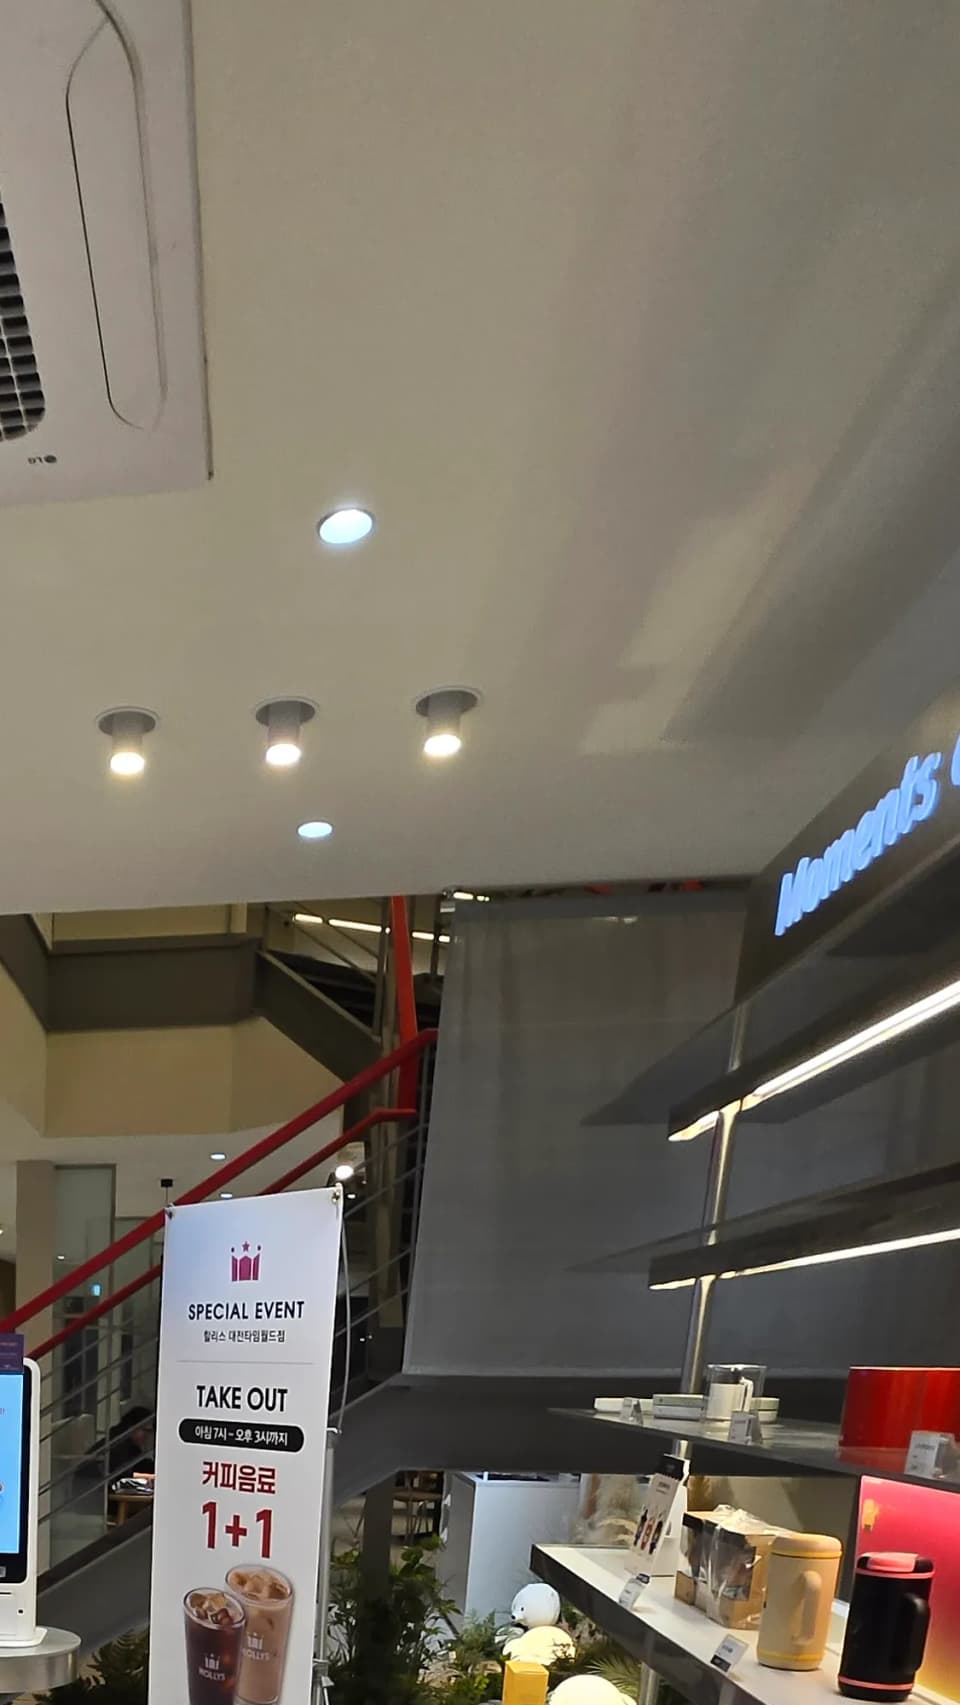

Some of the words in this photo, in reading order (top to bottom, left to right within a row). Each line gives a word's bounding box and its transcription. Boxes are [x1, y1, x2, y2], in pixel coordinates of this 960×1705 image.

[774, 752, 941, 936] Moments
[188, 1302, 248, 1320] SPECIAL
[254, 1301, 304, 1319] EVENT
[196, 1385, 241, 1409] TAKE
[247, 1387, 288, 1412] OUT
[195, 1425, 212, 1439] 아침
[213, 1427, 227, 1440] 7시
[235, 1429, 252, 1443] 오후
[254, 1430, 288, 1446] 3시까지
[202, 1461, 276, 1494] 커피음료
[202, 1501, 273, 1559] 1+1
[198, 1666, 226, 1681] HOLLYS
